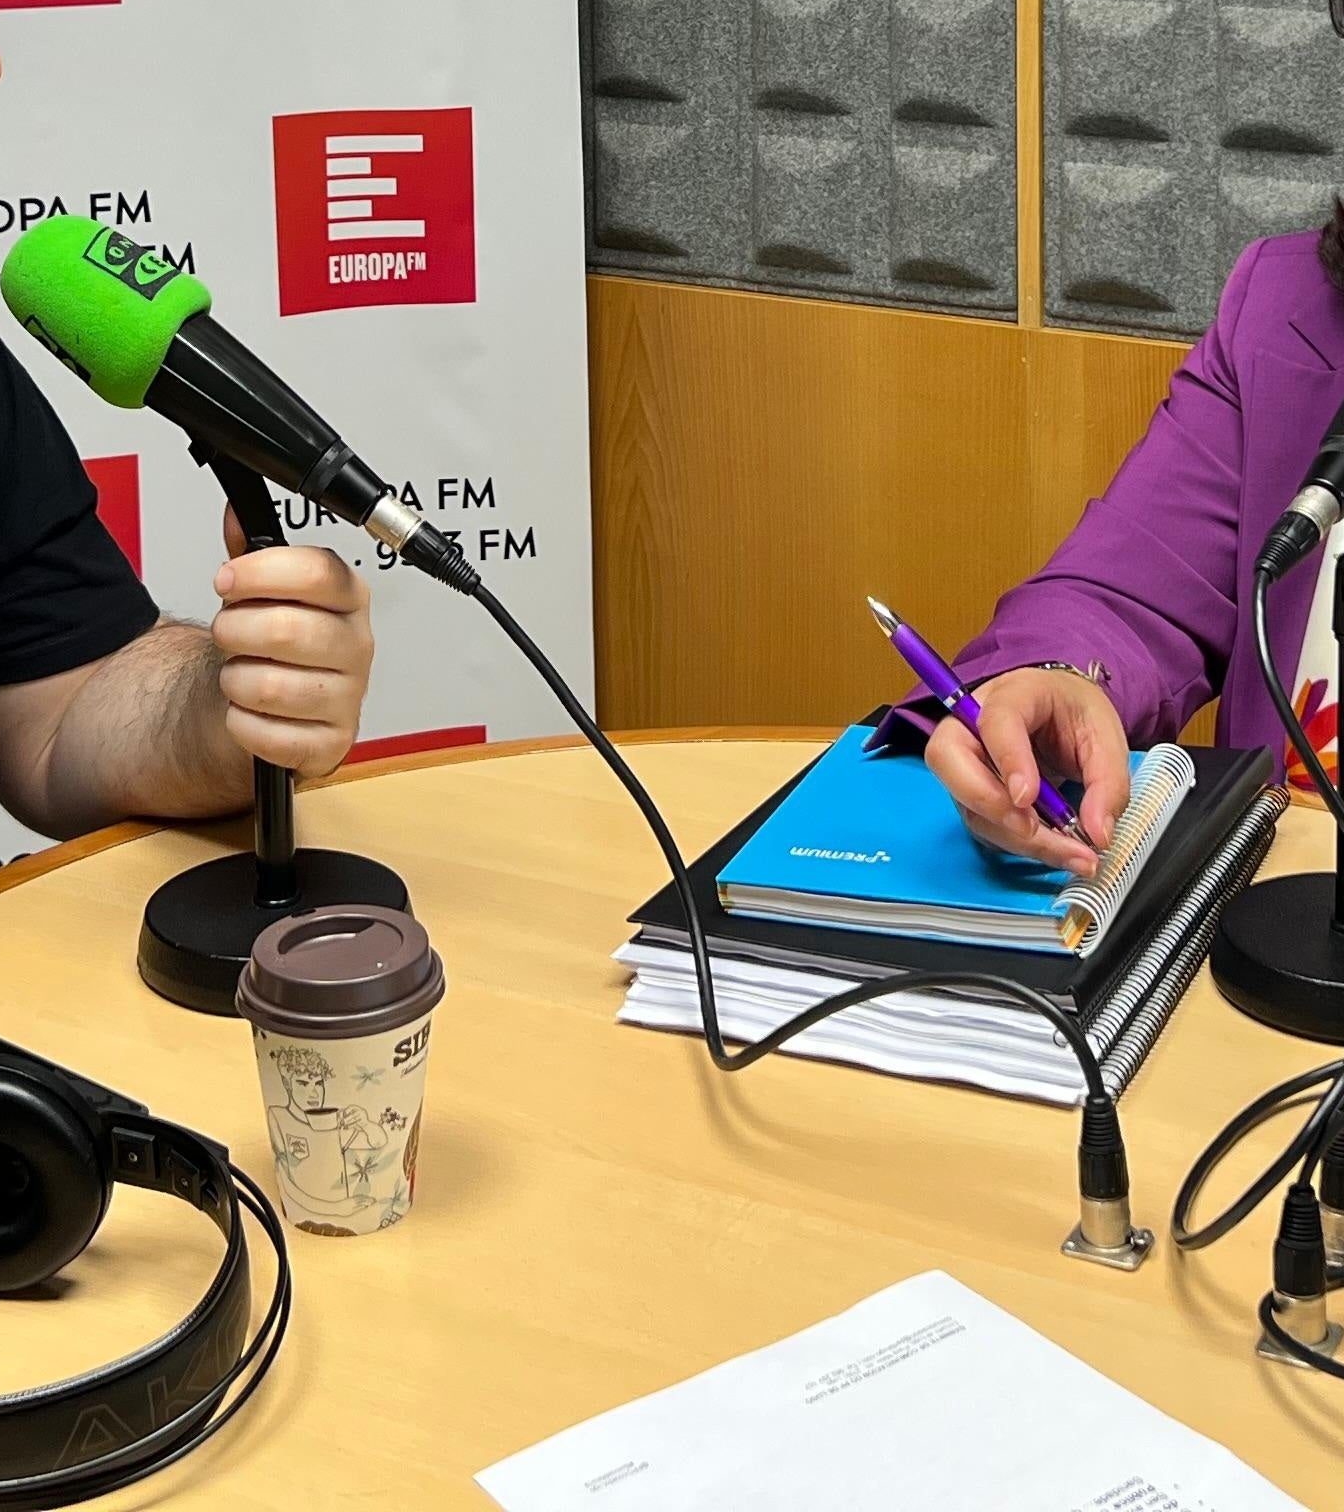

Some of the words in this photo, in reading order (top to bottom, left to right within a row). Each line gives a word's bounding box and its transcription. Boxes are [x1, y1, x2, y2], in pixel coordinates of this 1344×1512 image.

[88, 186, 154, 226] FM
[439, 477, 497, 511] FM
[480, 527, 538, 562] FM
